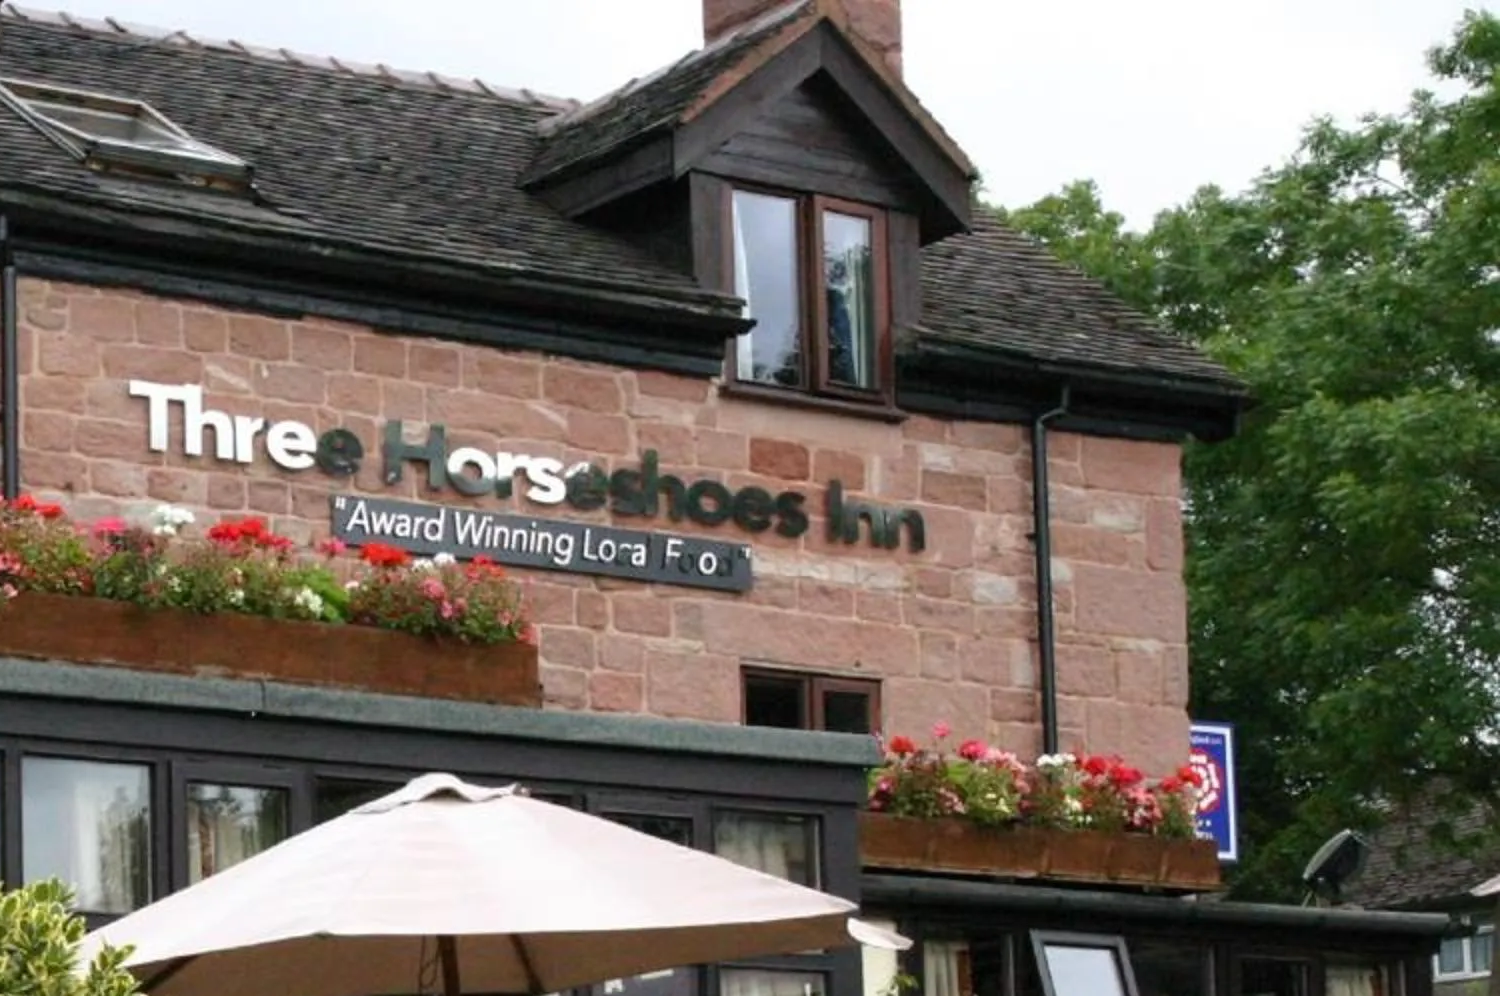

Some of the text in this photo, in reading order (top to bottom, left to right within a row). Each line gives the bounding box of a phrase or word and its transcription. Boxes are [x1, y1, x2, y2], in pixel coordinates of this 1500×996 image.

[129, 379, 926, 555] Three Horseshoes Inn
[454, 511, 575, 566] Winning
